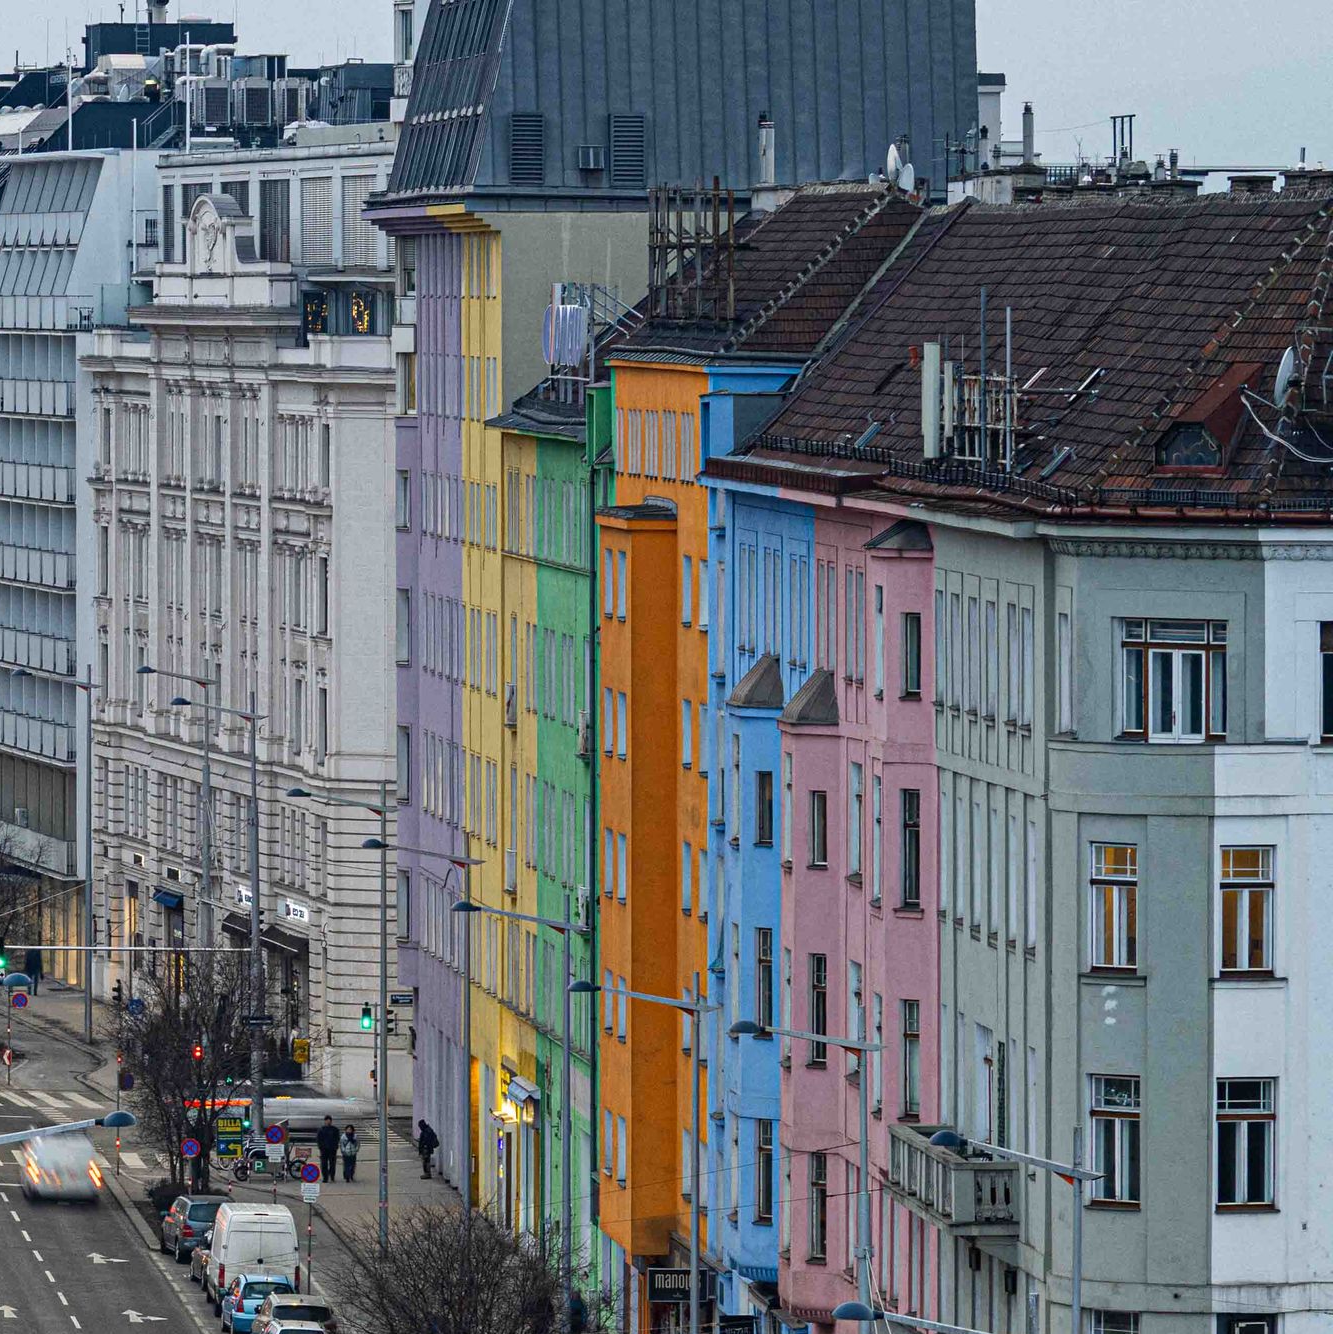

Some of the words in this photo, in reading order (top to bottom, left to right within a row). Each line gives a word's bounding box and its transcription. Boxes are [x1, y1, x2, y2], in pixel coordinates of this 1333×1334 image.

[218, 1119, 241, 1127] BILLA
[255, 1161, 263, 1171] P
[655, 1273, 702, 1291] manols
